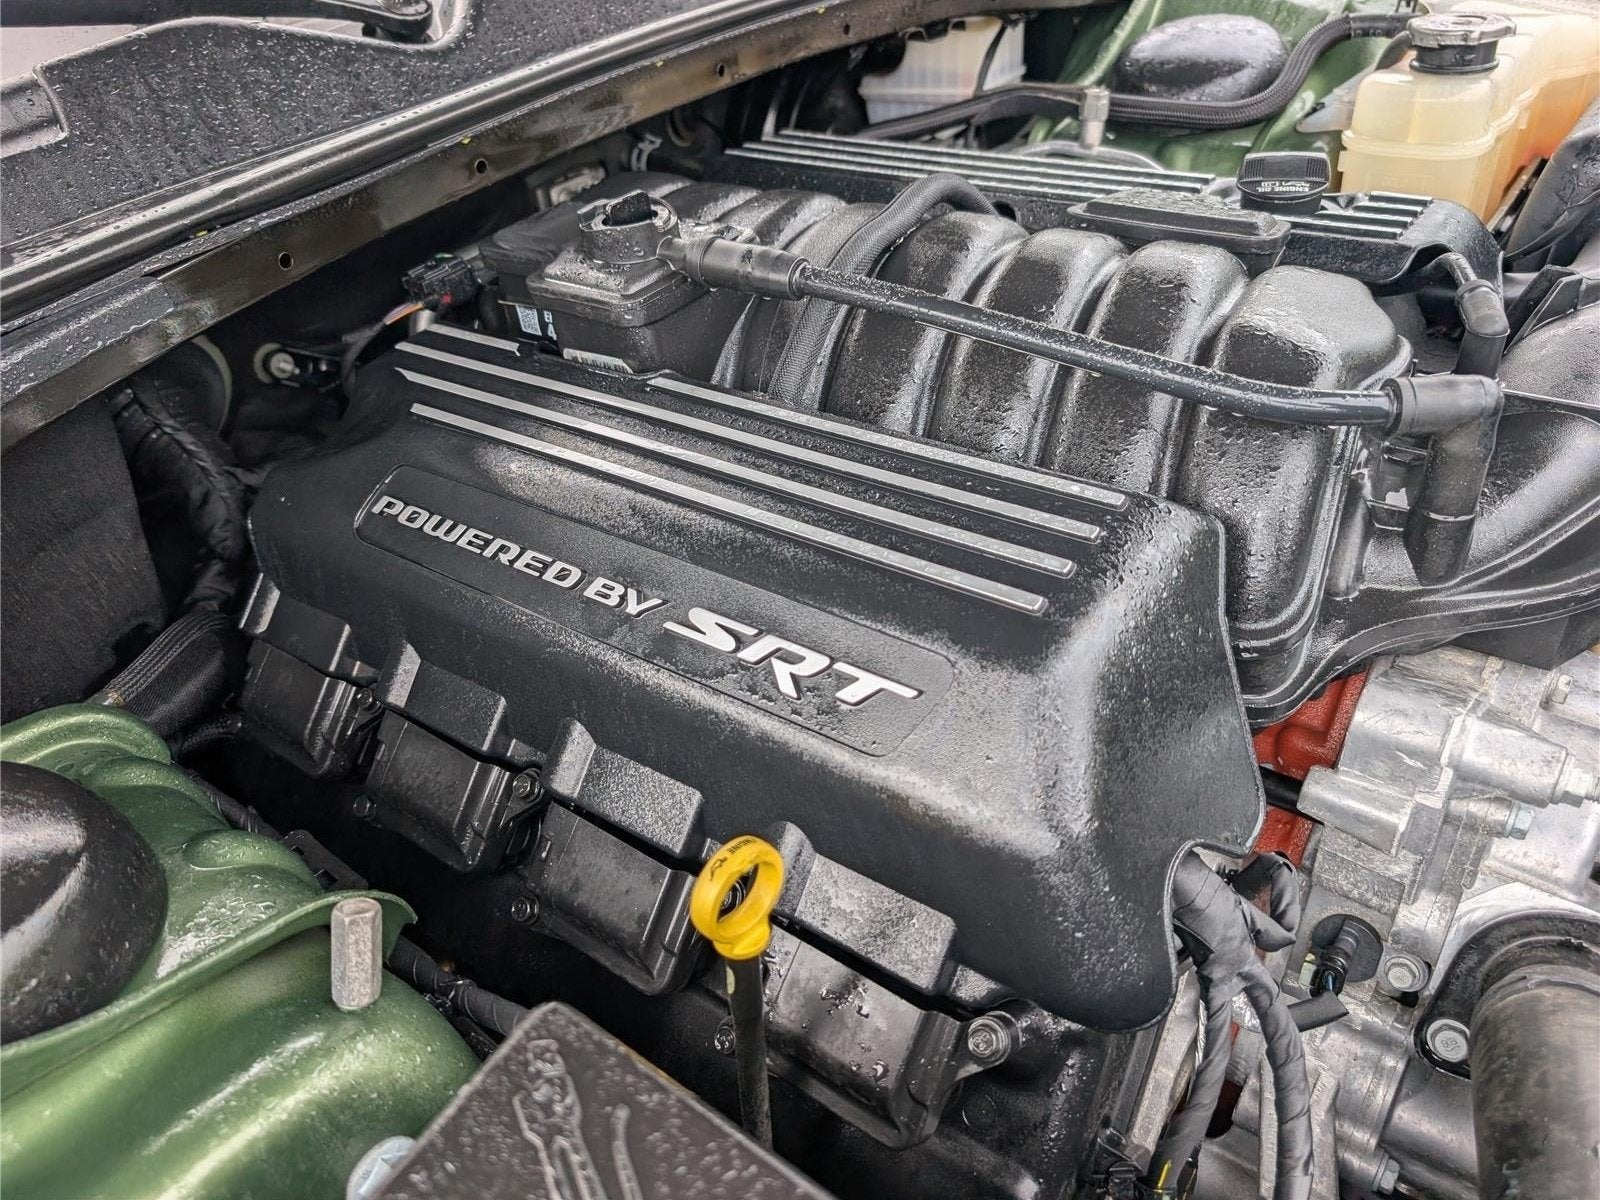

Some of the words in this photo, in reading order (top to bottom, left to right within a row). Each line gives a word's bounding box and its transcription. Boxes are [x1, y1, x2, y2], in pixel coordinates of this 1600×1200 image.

[371, 495, 584, 589] POWERED
[583, 576, 666, 618] BY
[662, 606, 923, 706] SRT
